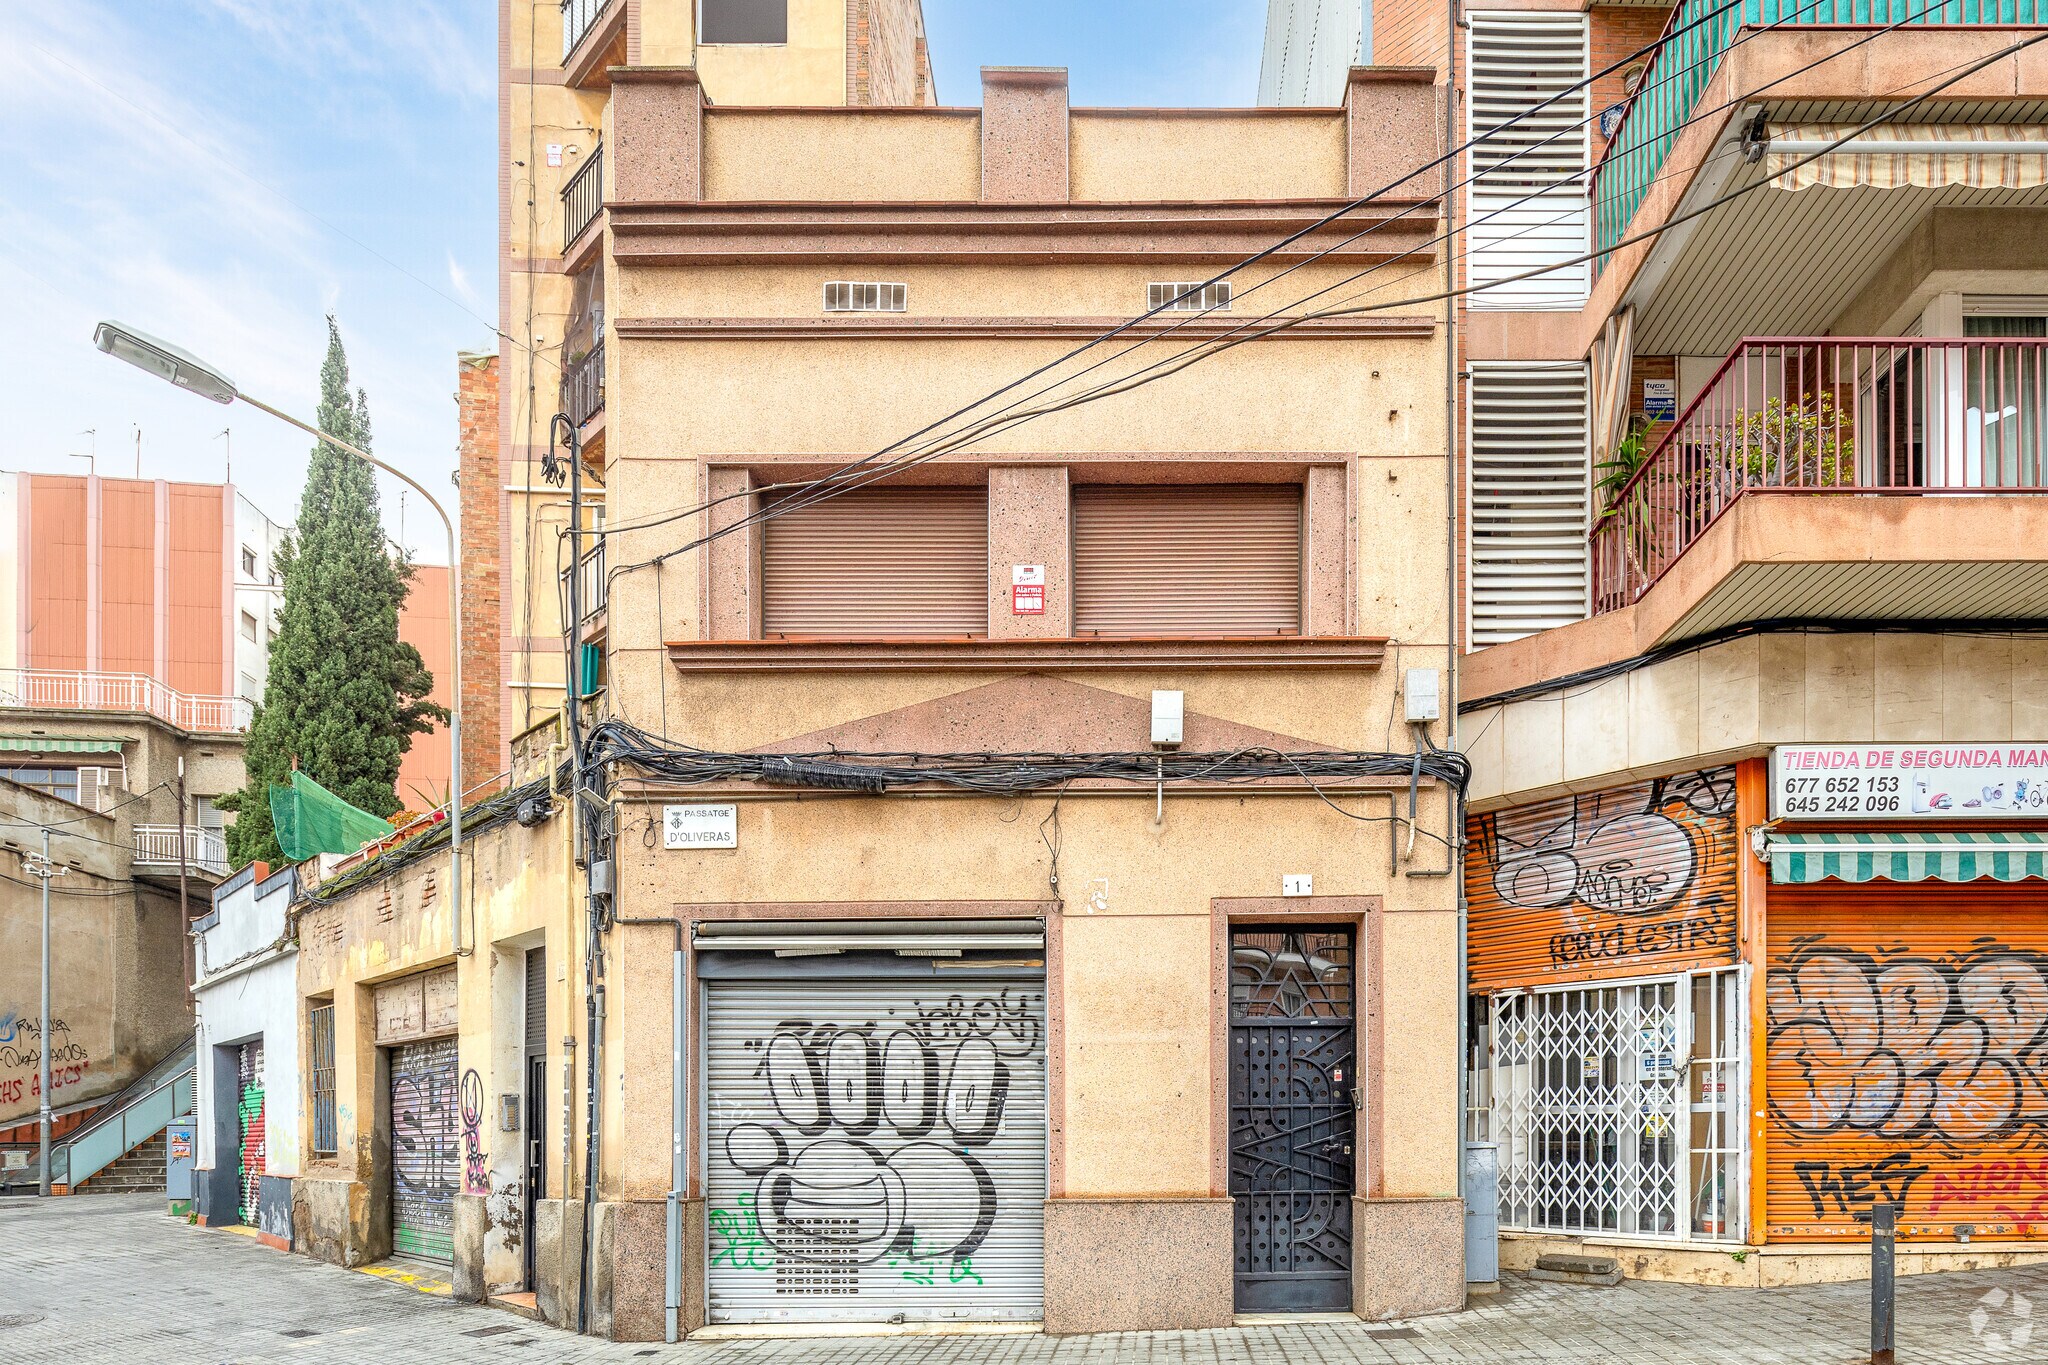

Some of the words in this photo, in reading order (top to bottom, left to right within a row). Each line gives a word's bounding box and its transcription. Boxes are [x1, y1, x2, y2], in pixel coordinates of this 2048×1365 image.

[1016, 586, 1042, 594] Alarma
[1784, 751, 1860, 770] TIENDA
[1866, 750, 1895, 769] DE
[1900, 750, 2002, 768] SEGUNDA
[1785, 778, 1820, 793] 677
[1825, 777, 1860, 792] 652
[1866, 777, 1899, 792] 153
[1785, 796, 1820, 812] 645
[1825, 796, 1860, 812] 242
[1866, 796, 1899, 811] 096
[670, 831, 731, 842] D'OLIVERAS
[1296, 881, 1300, 893] 1
[0, 1078, 23, 1104] HS
